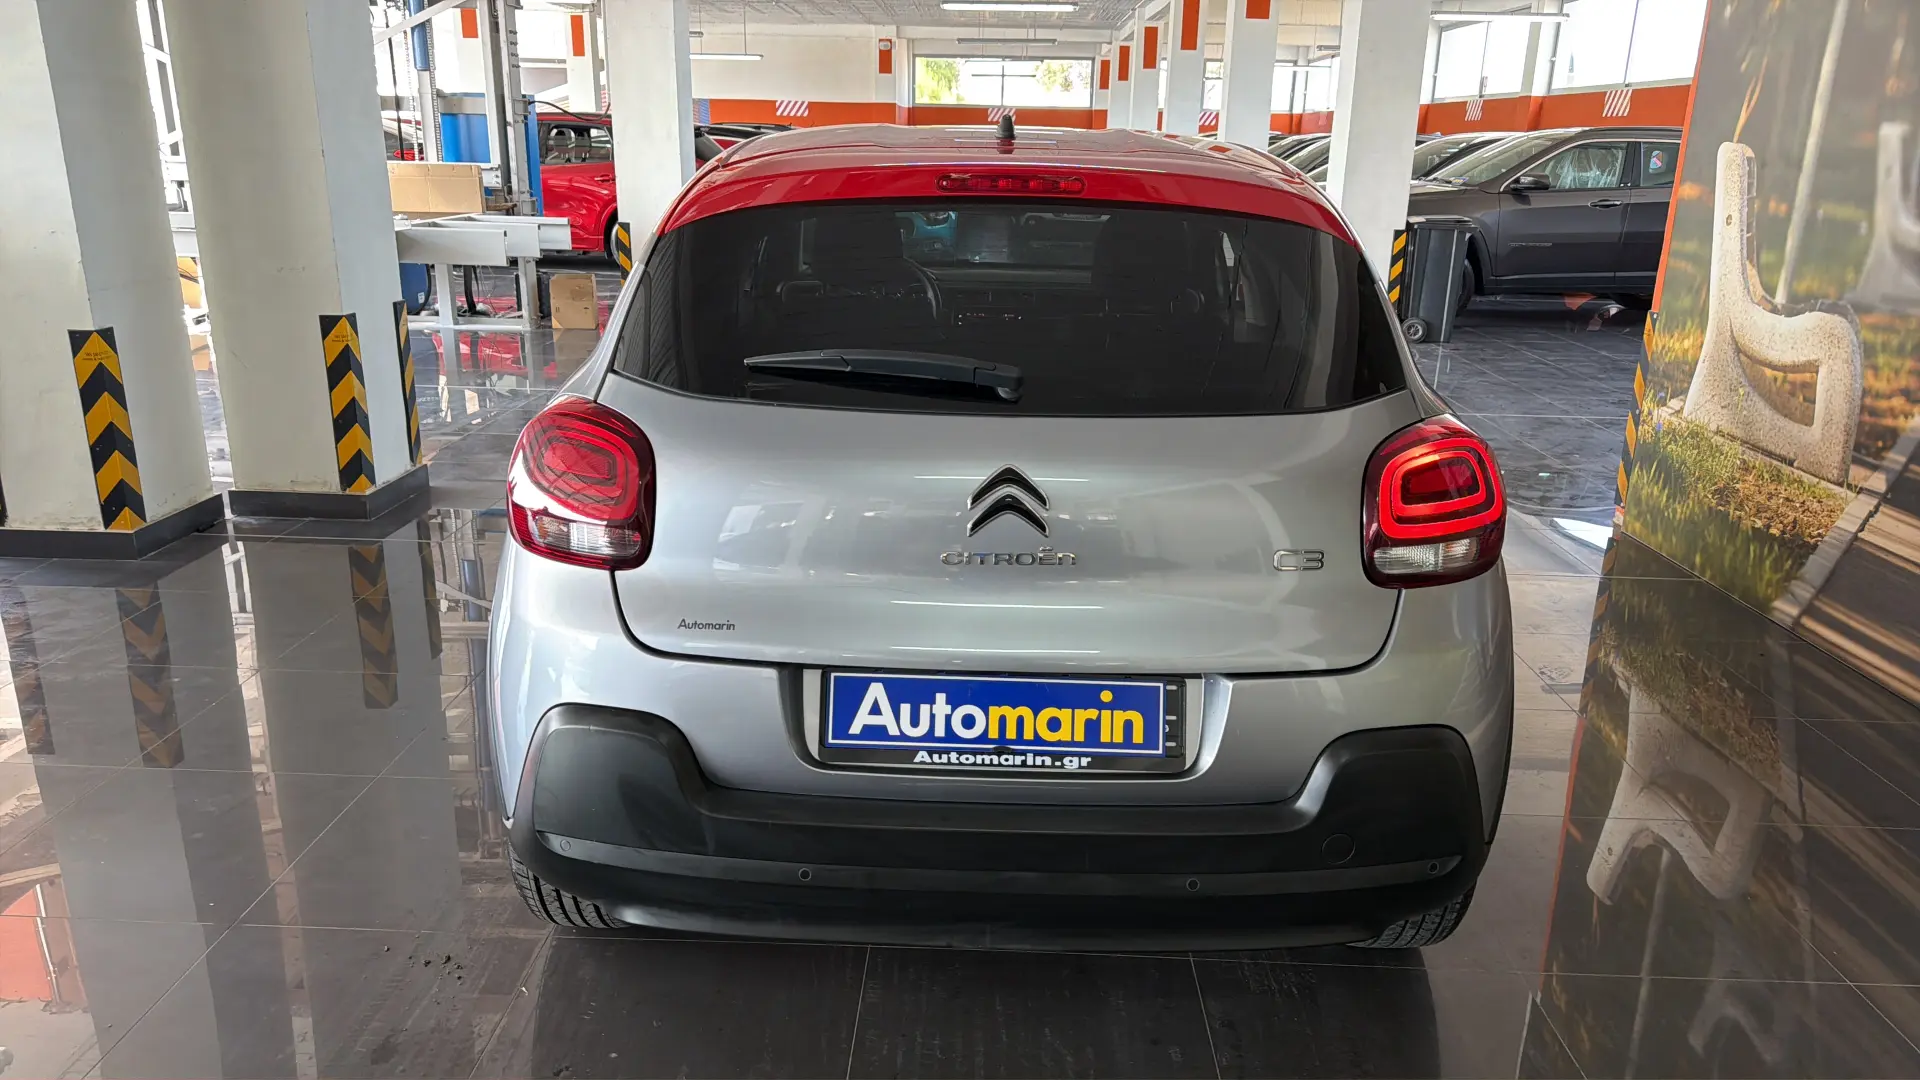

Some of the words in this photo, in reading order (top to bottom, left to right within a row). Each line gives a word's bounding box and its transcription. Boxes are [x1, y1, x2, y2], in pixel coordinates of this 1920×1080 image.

[1273, 549, 1324, 571] C3
[677, 618, 736, 631] Automarin
[848, 682, 1144, 744] Automarin
[913, 750, 1092, 769] Automarin.gr
